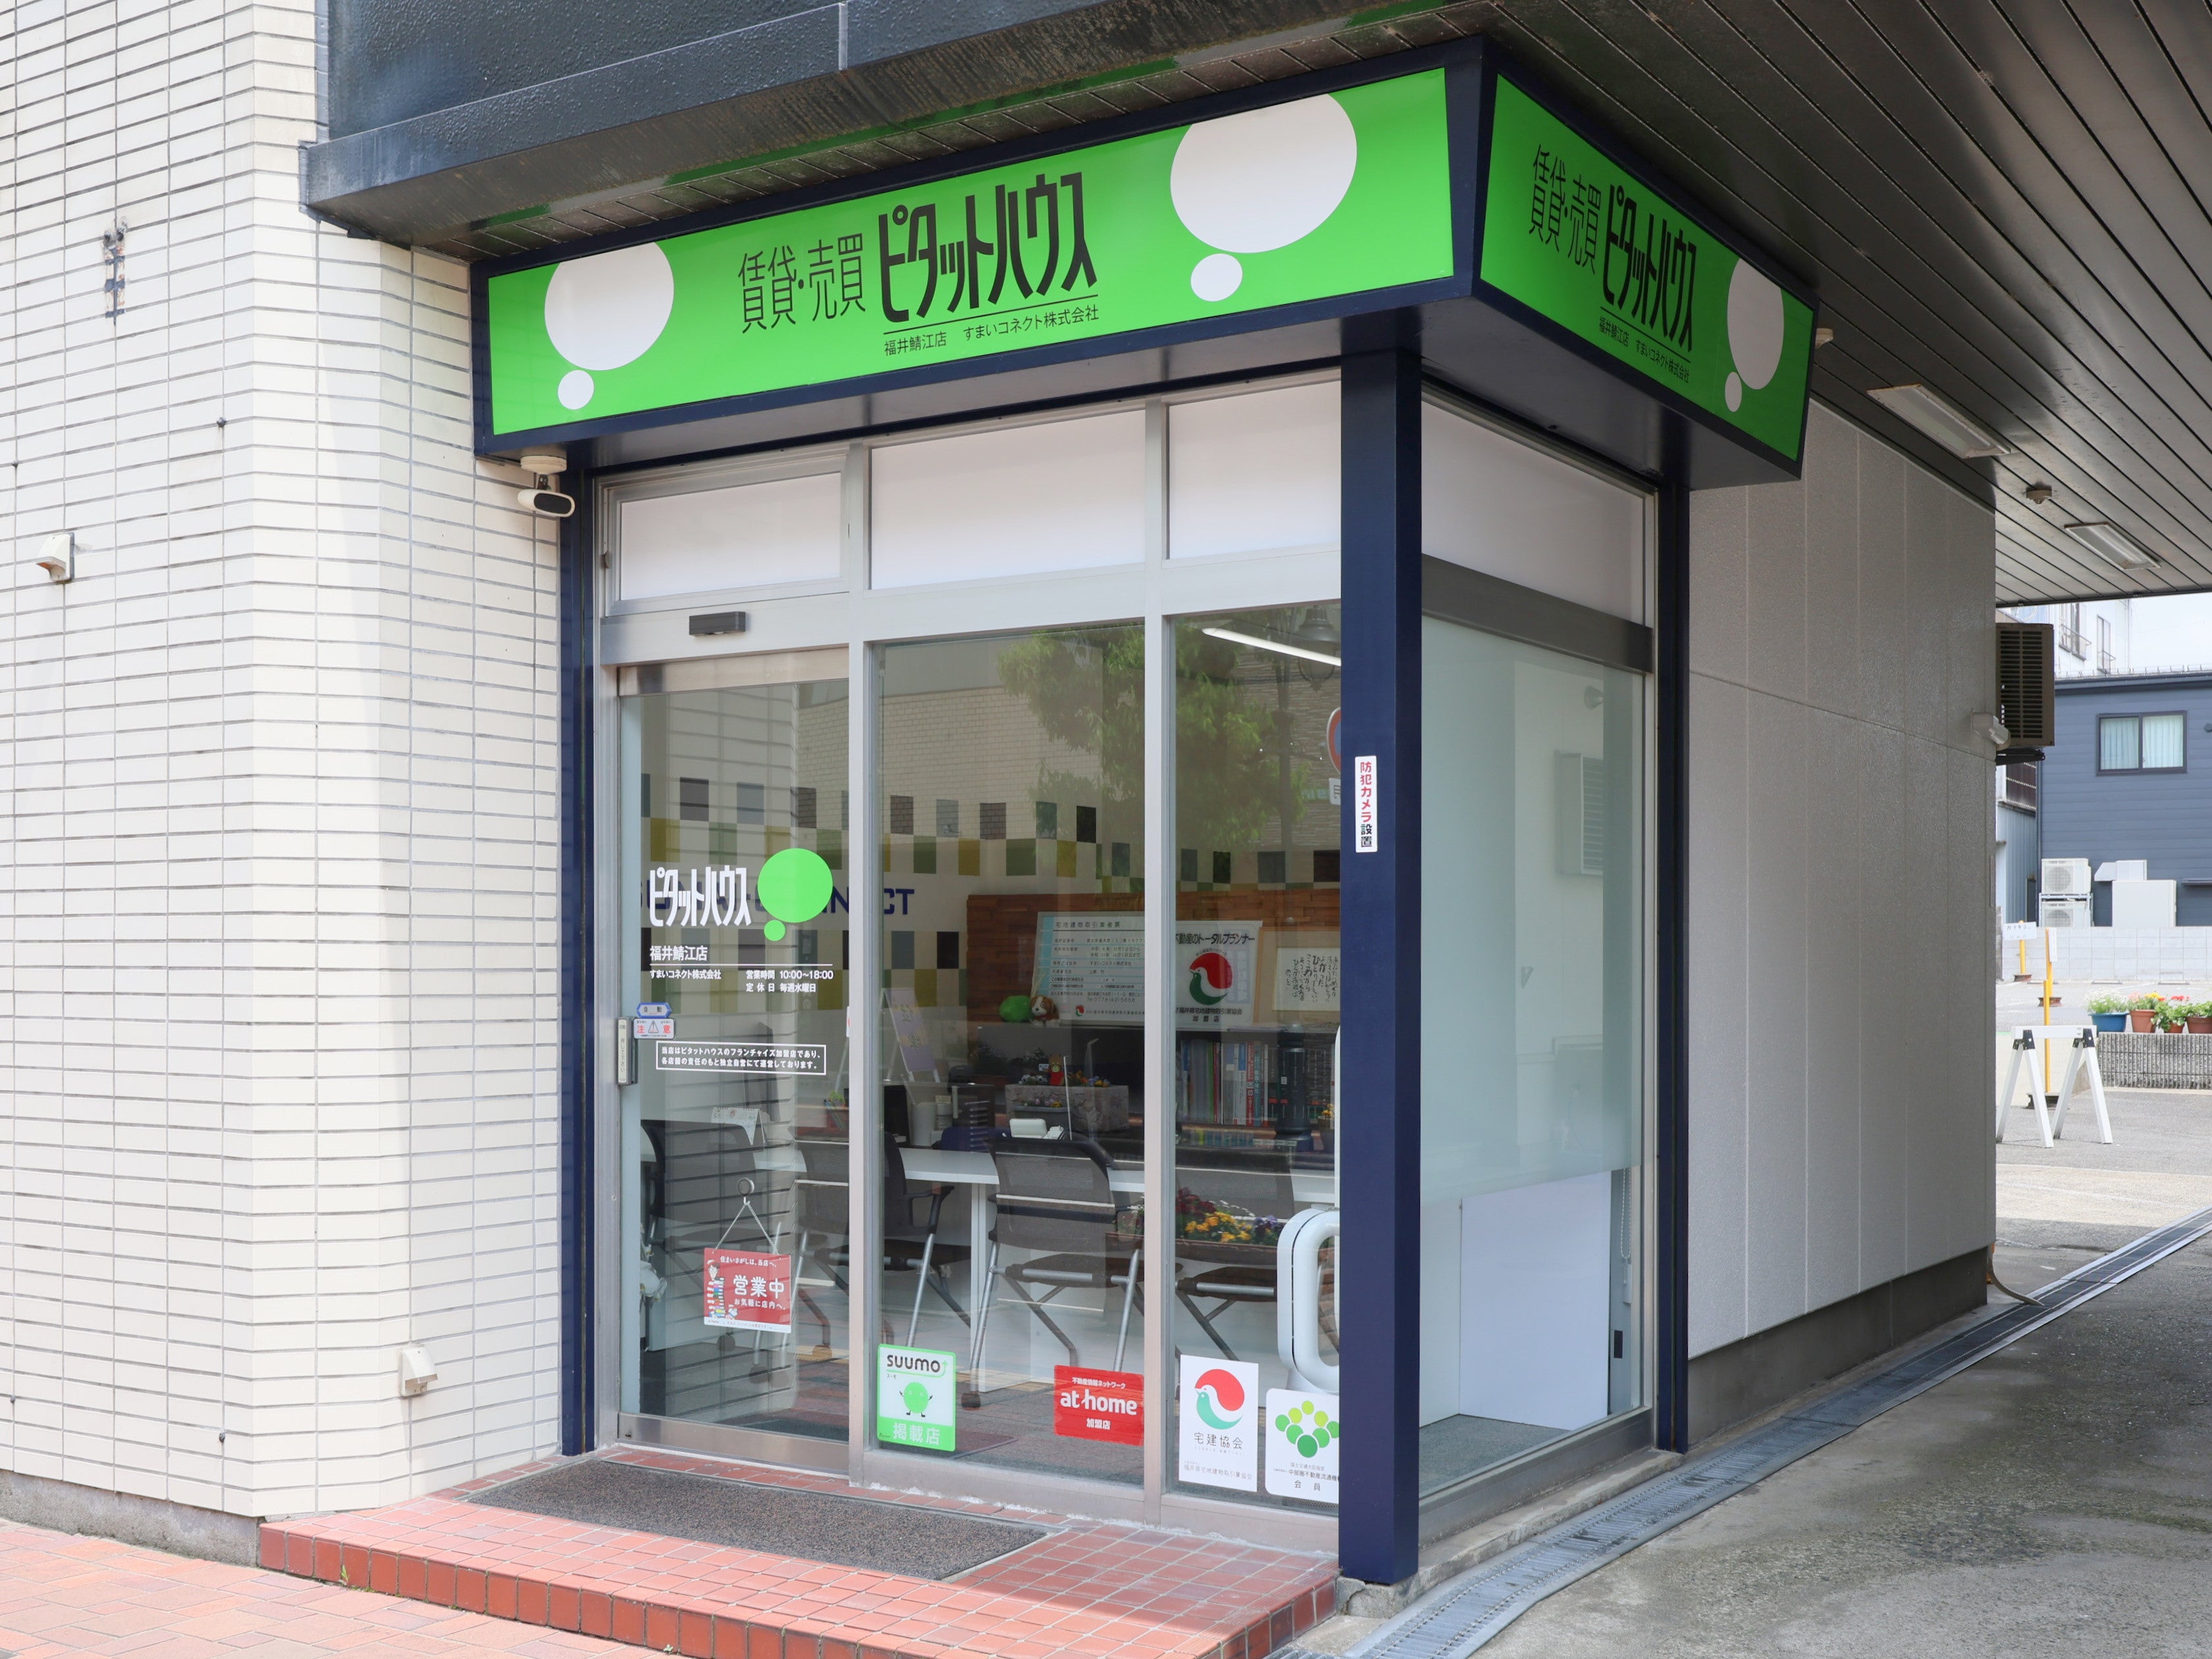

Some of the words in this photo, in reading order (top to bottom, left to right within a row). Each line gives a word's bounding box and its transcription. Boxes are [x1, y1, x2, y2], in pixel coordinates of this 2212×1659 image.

[738, 232, 866, 334] 賃貸・売買
[878, 171, 1098, 323] ピタットハウス
[1529, 144, 1602, 275] 賃貸・売買
[1603, 184, 1697, 353] ピタットハウス
[883, 331, 947, 357] 福井鯖江店
[963, 304, 1099, 342] すまいコネクト株式会社
[1599, 316, 1630, 348] 福井鯖江店
[1635, 338, 1690, 384] すまいコネクト株式会社
[1359, 761, 1373, 848] 防犯カメラ設置
[649, 864, 752, 928] ピタットハウス
[649, 945, 708, 962] 福井鯖江店
[649, 969, 722, 980] すまいコネクト株式会社
[746, 969, 776, 980] 営業時間
[746, 982, 775, 993] 定休日
[779, 983, 817, 993] 毎週水曜日
[732, 1274, 785, 1300] 営業中
[1072, 1376, 1126, 1390] 不動産情報ネットワーク
[1059, 1390, 1080, 1409] at
[1080, 1388, 1138, 1416] home
[892, 1421, 941, 1446] 掲載店
[1086, 1417, 1111, 1431] 加盟店
[1194, 1431, 1244, 1450] 宅建協会
[1288, 1469, 1340, 1483] 中部圏不動産流通機
